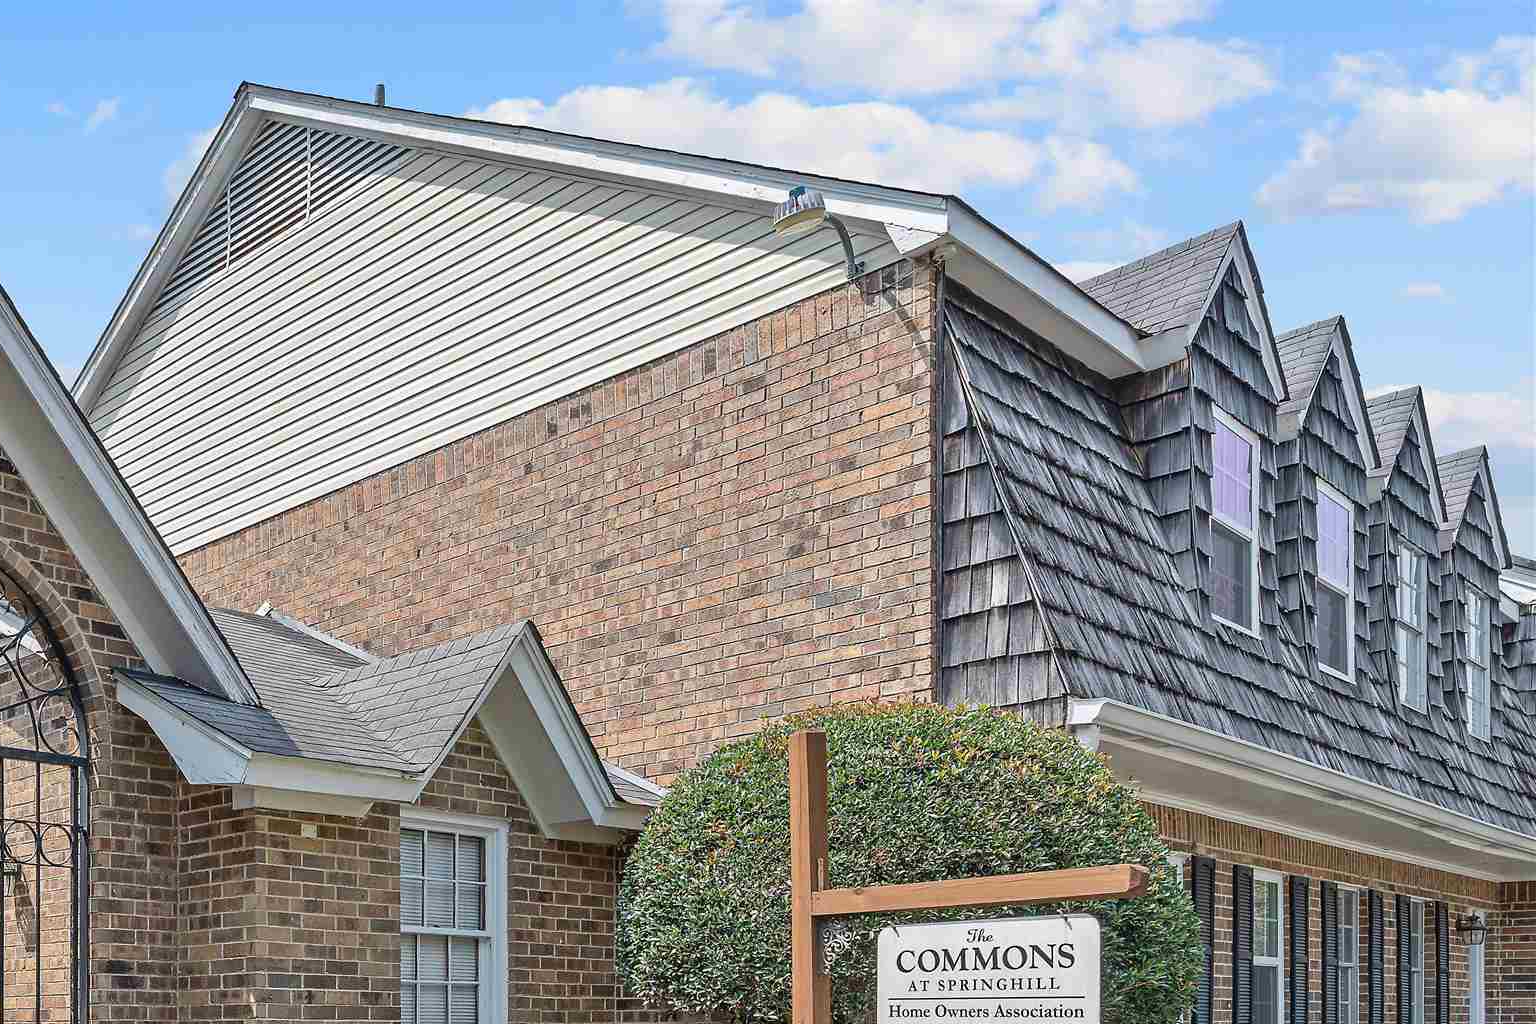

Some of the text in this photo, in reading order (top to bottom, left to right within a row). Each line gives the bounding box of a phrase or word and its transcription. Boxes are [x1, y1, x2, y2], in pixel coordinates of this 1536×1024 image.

[966, 928, 994, 944] The
[896, 943, 1076, 974] COMMONS
[907, 976, 1061, 993] AT SPRINGHILL
[888, 1003, 1085, 1019] Home Owners Association
